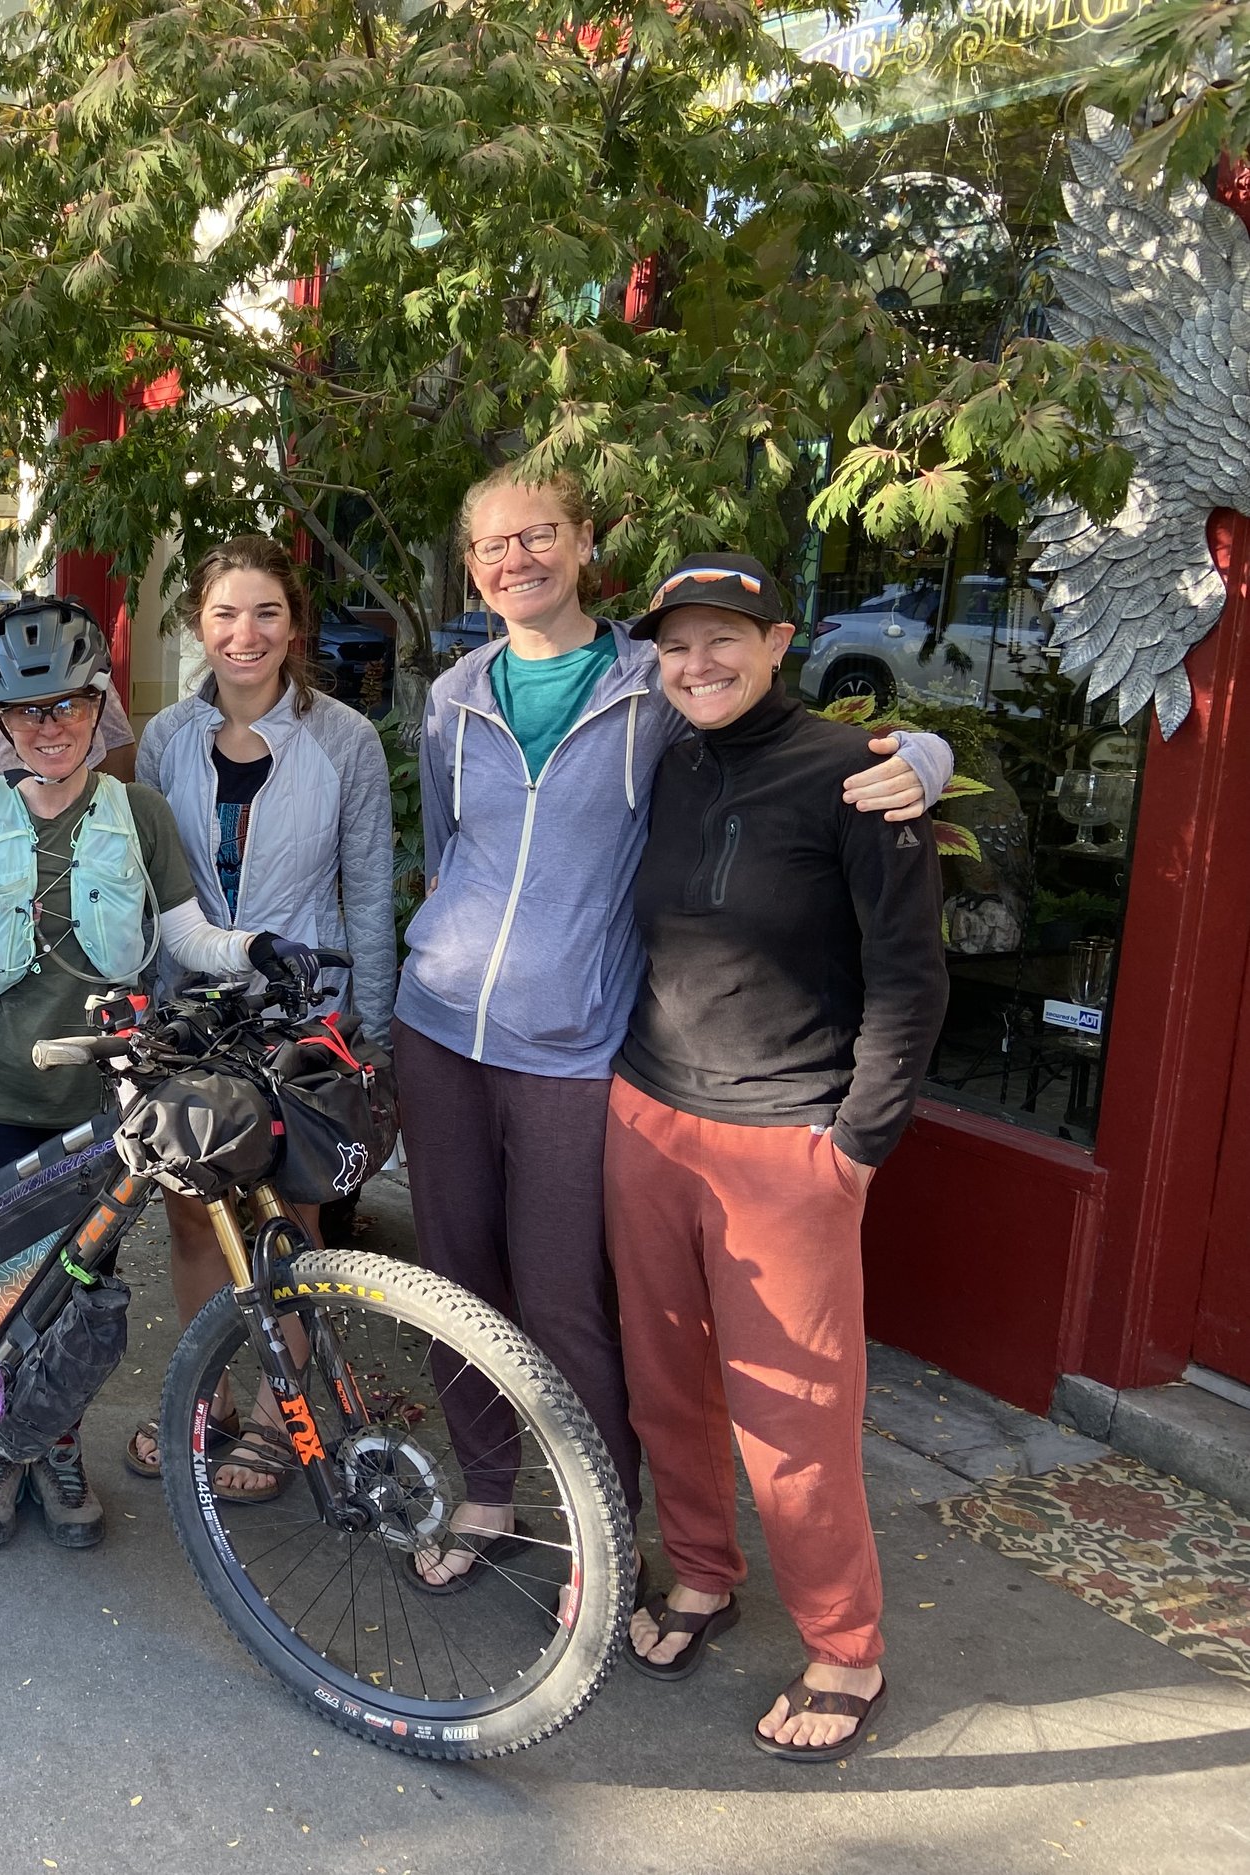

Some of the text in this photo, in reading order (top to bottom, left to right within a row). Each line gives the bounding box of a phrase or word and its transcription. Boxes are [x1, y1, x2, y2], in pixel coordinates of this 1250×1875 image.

[1069, 1015, 1078, 1023] by
[1079, 1013, 1099, 1028] ADT
[273, 1282, 386, 1301] MAXXIS
[280, 1393, 326, 1466] FOX
[192, 1403, 215, 1513] DT SWISS XM481
[442, 1725, 479, 1742] IKON
